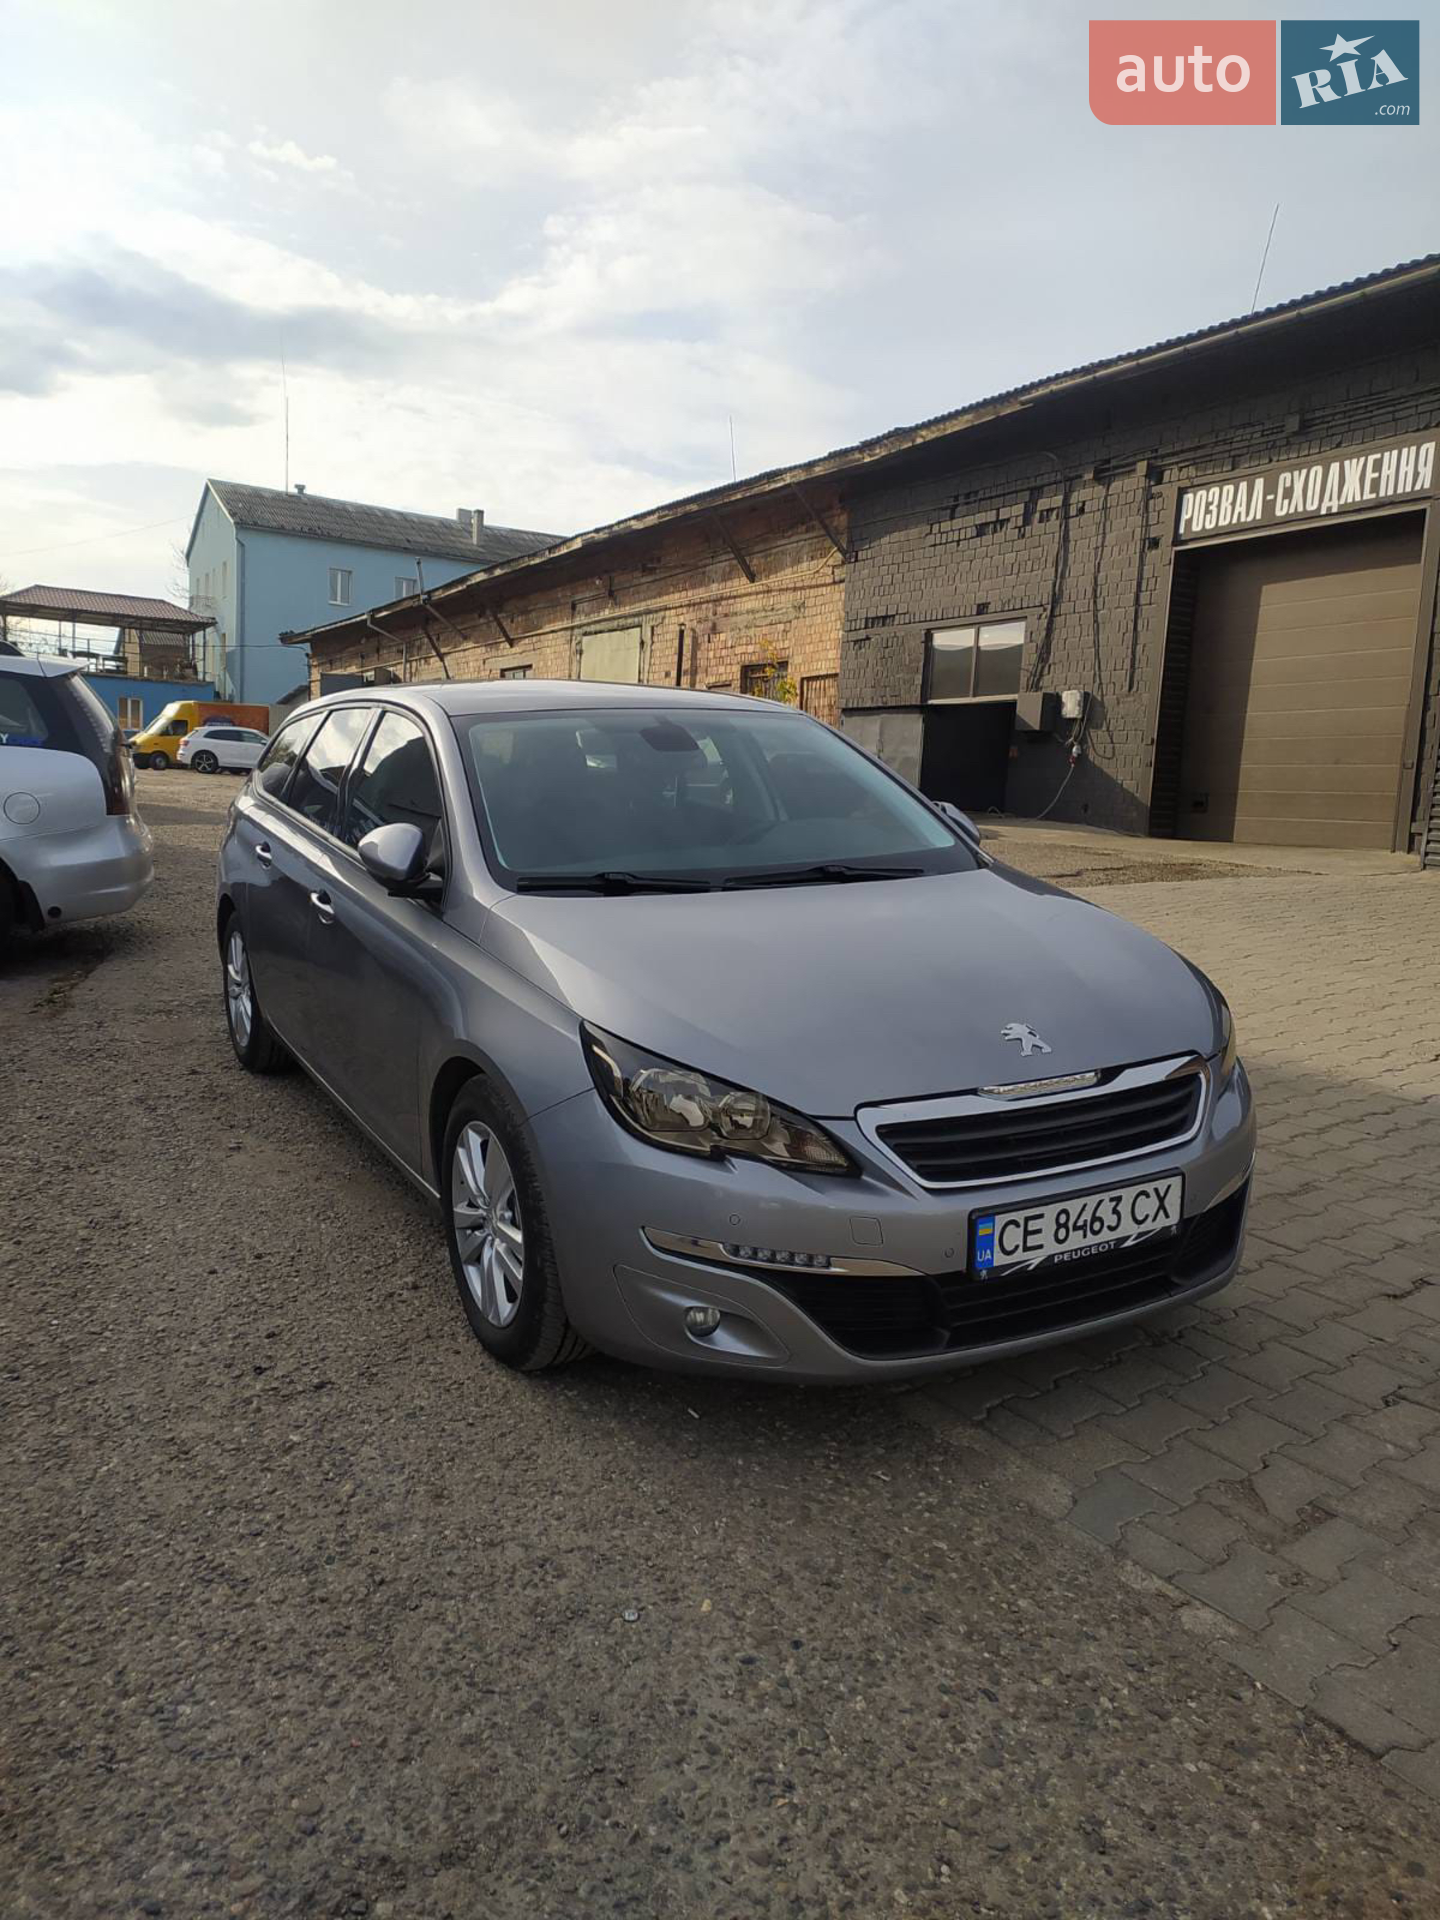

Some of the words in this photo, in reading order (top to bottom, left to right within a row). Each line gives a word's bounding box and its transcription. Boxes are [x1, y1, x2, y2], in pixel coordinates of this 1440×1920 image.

[1179, 441, 1436, 534] РОЗВАЛ-СХОДЖЕННЯ
[998, 1213, 1045, 1255] CE
[1054, 1194, 1123, 1245] 8463
[1131, 1184, 1172, 1225] CX
[977, 1249, 992, 1261] UA
[1054, 1240, 1116, 1264] PEUGEOT
